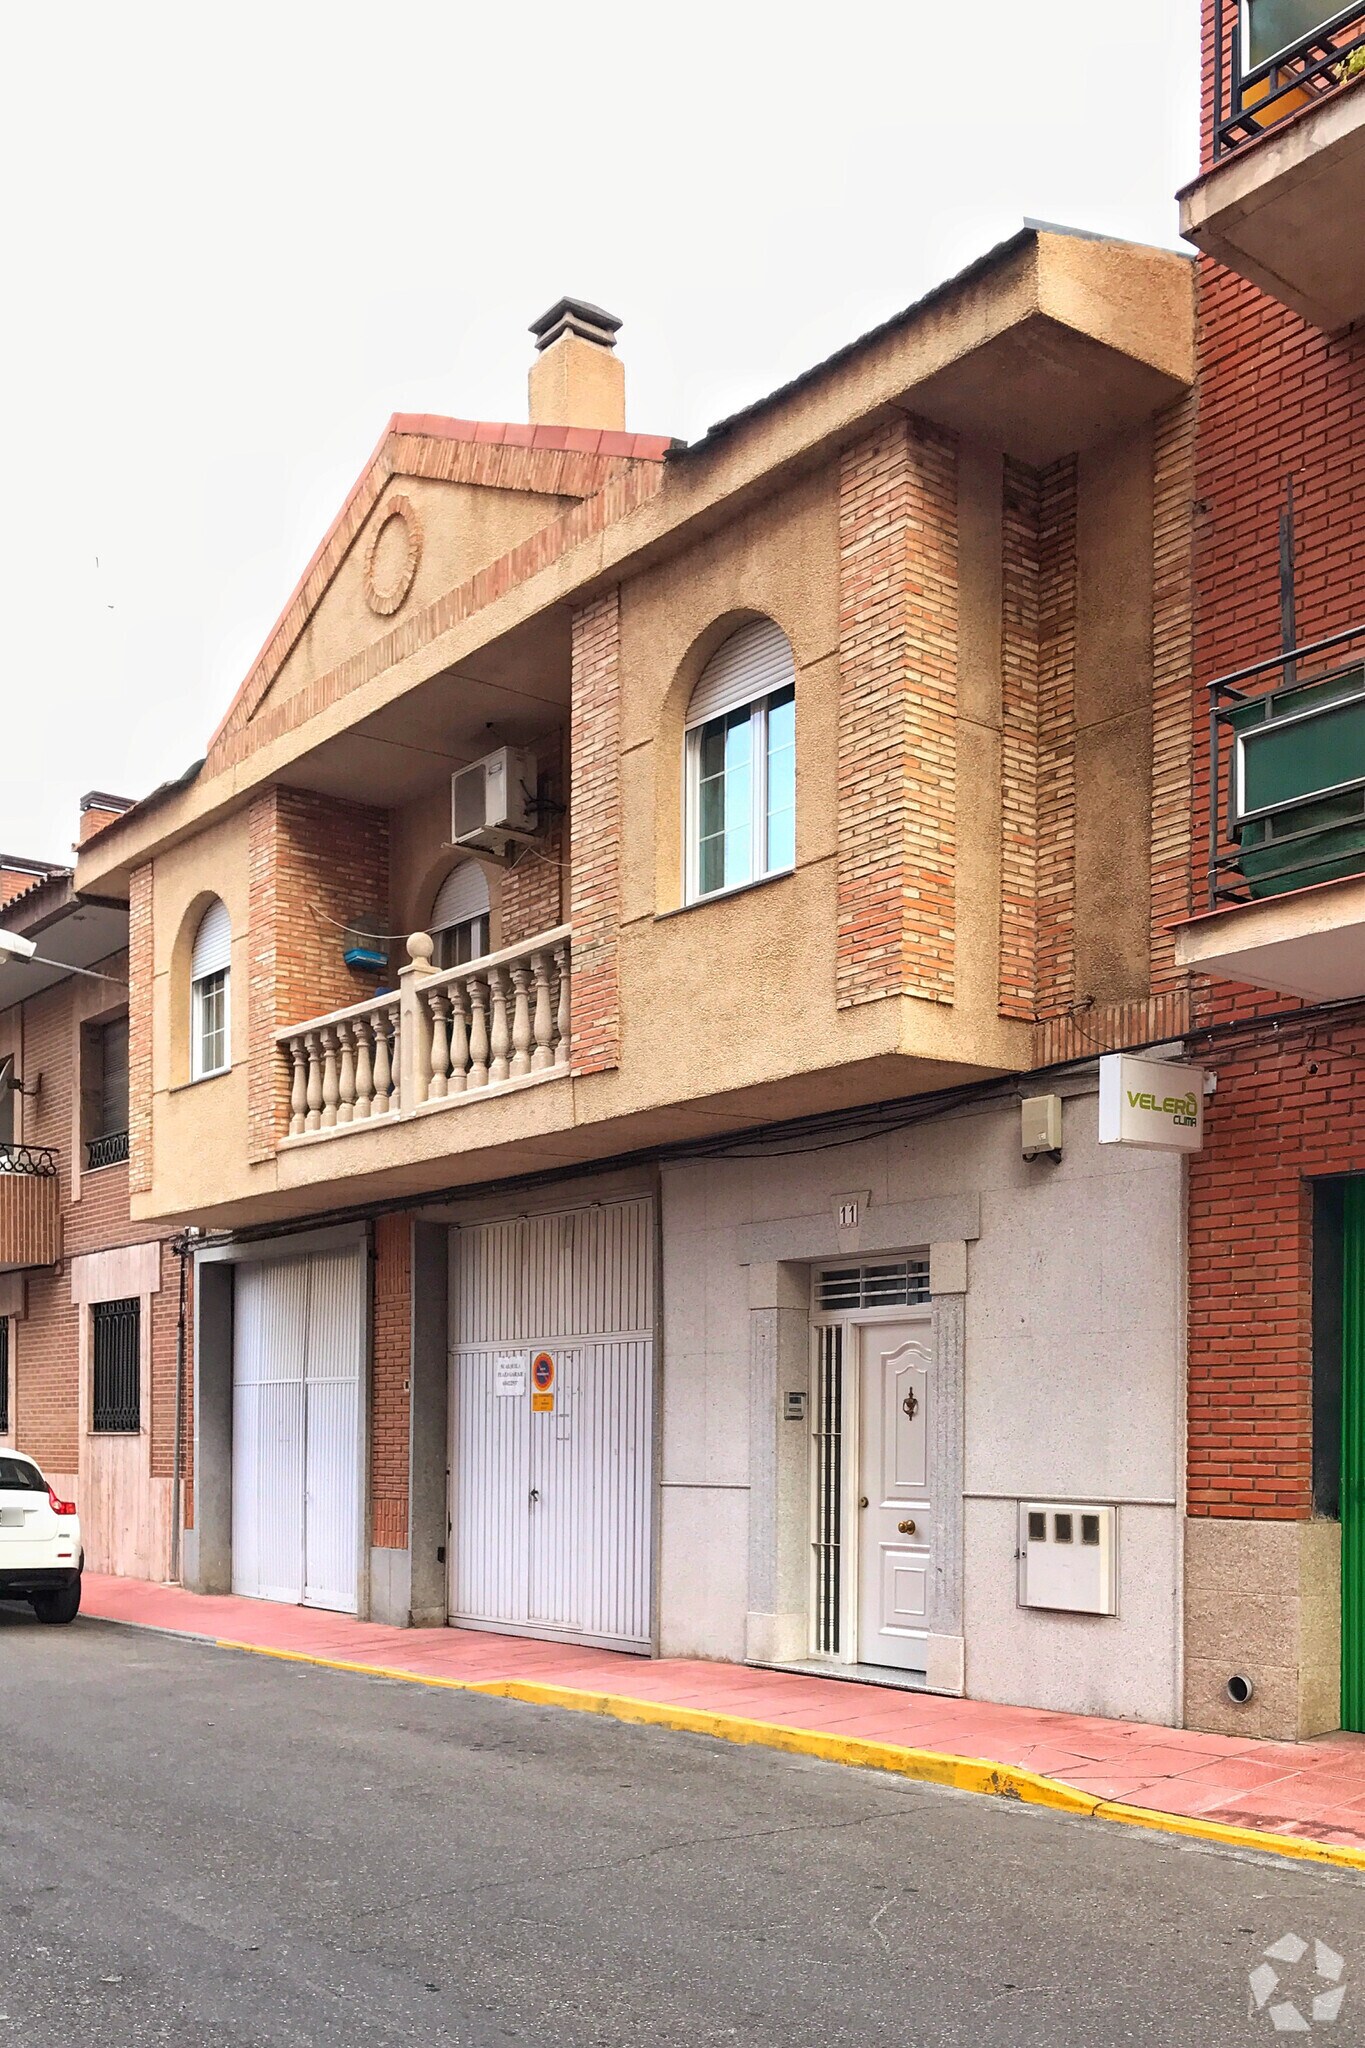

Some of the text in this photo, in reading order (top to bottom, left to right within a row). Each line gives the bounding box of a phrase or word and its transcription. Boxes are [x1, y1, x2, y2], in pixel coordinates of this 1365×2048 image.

[1127, 1091, 1197, 1116] VELERO
[1173, 1115, 1196, 1127] CLIMA
[841, 1205, 854, 1223] 11
